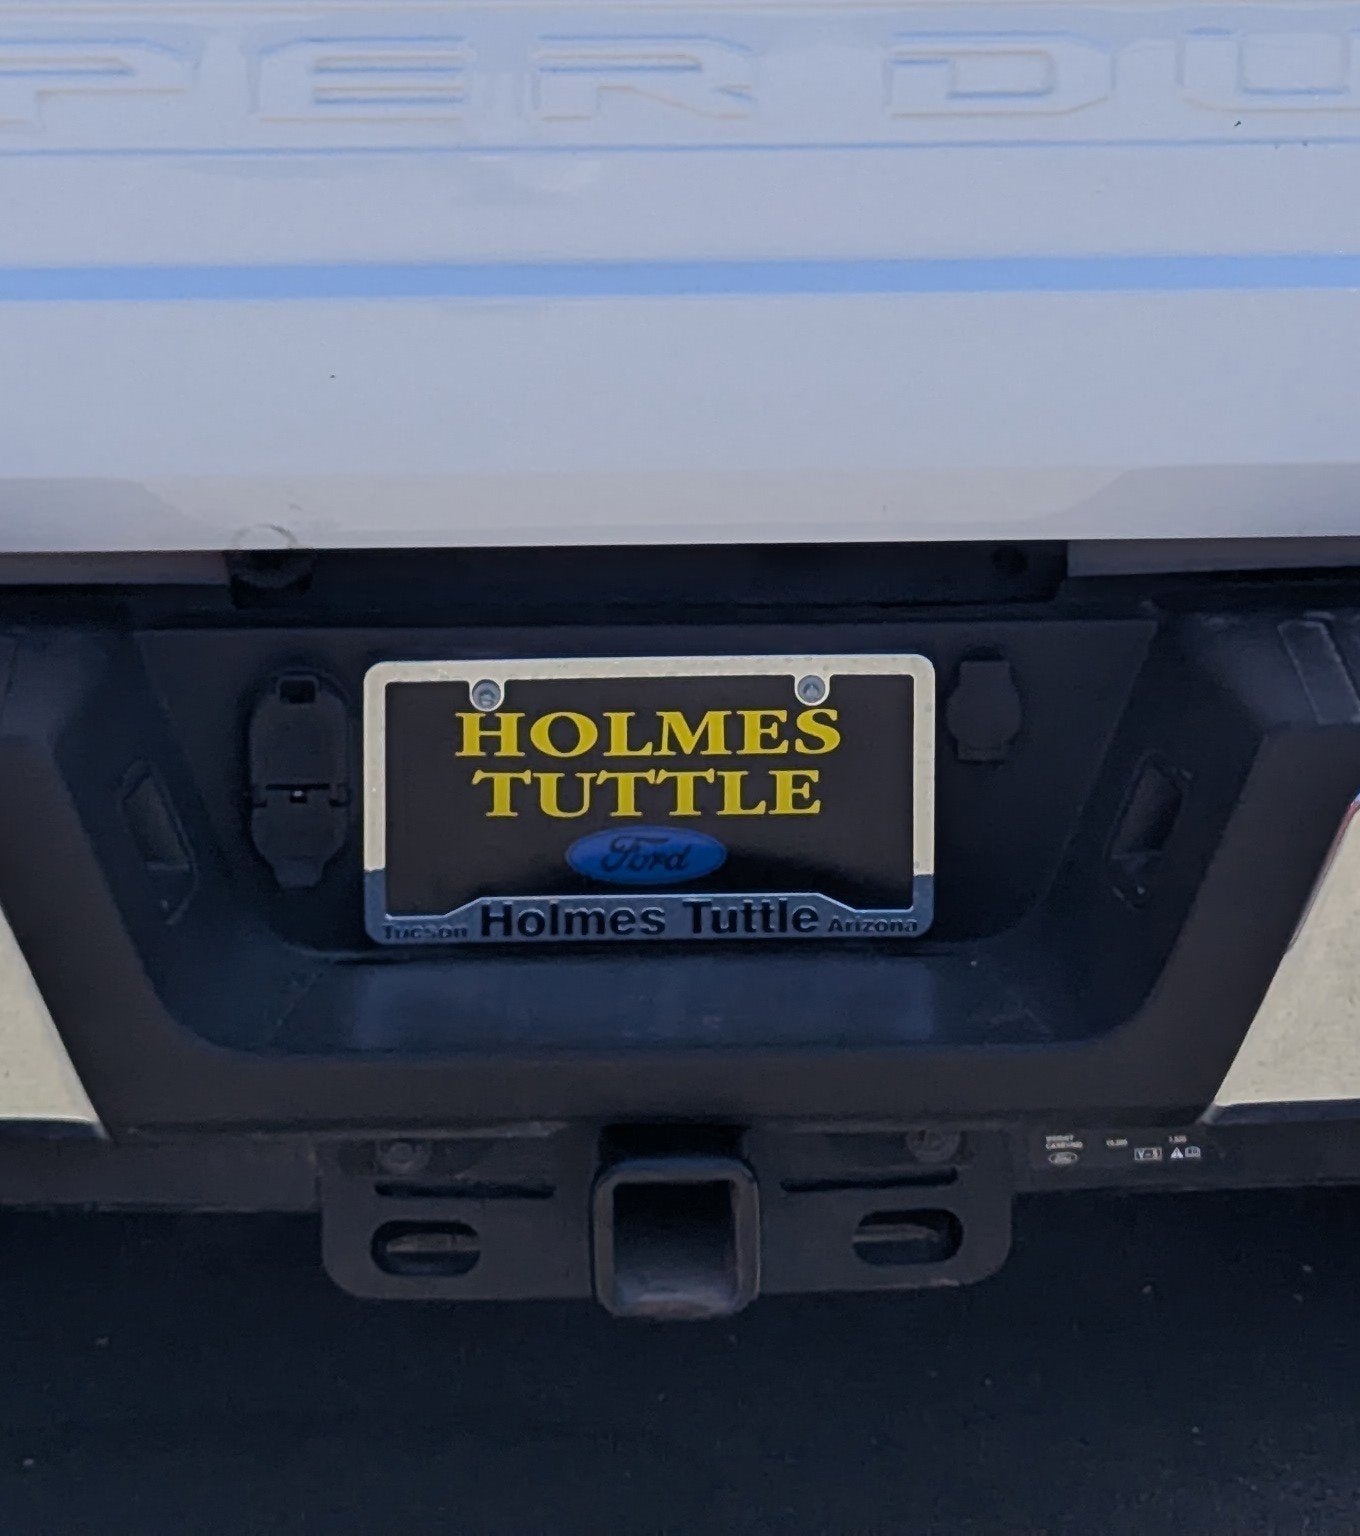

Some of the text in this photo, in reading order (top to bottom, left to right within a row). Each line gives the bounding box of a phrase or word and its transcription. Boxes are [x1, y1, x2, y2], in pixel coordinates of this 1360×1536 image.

[454, 708, 841, 758] HOLMES
[472, 768, 822, 818] TUTTLE
[600, 835, 691, 873] Ford
[479, 900, 666, 937] Holmes
[682, 897, 820, 935] Tuttle
[827, 916, 918, 933] Arizona
